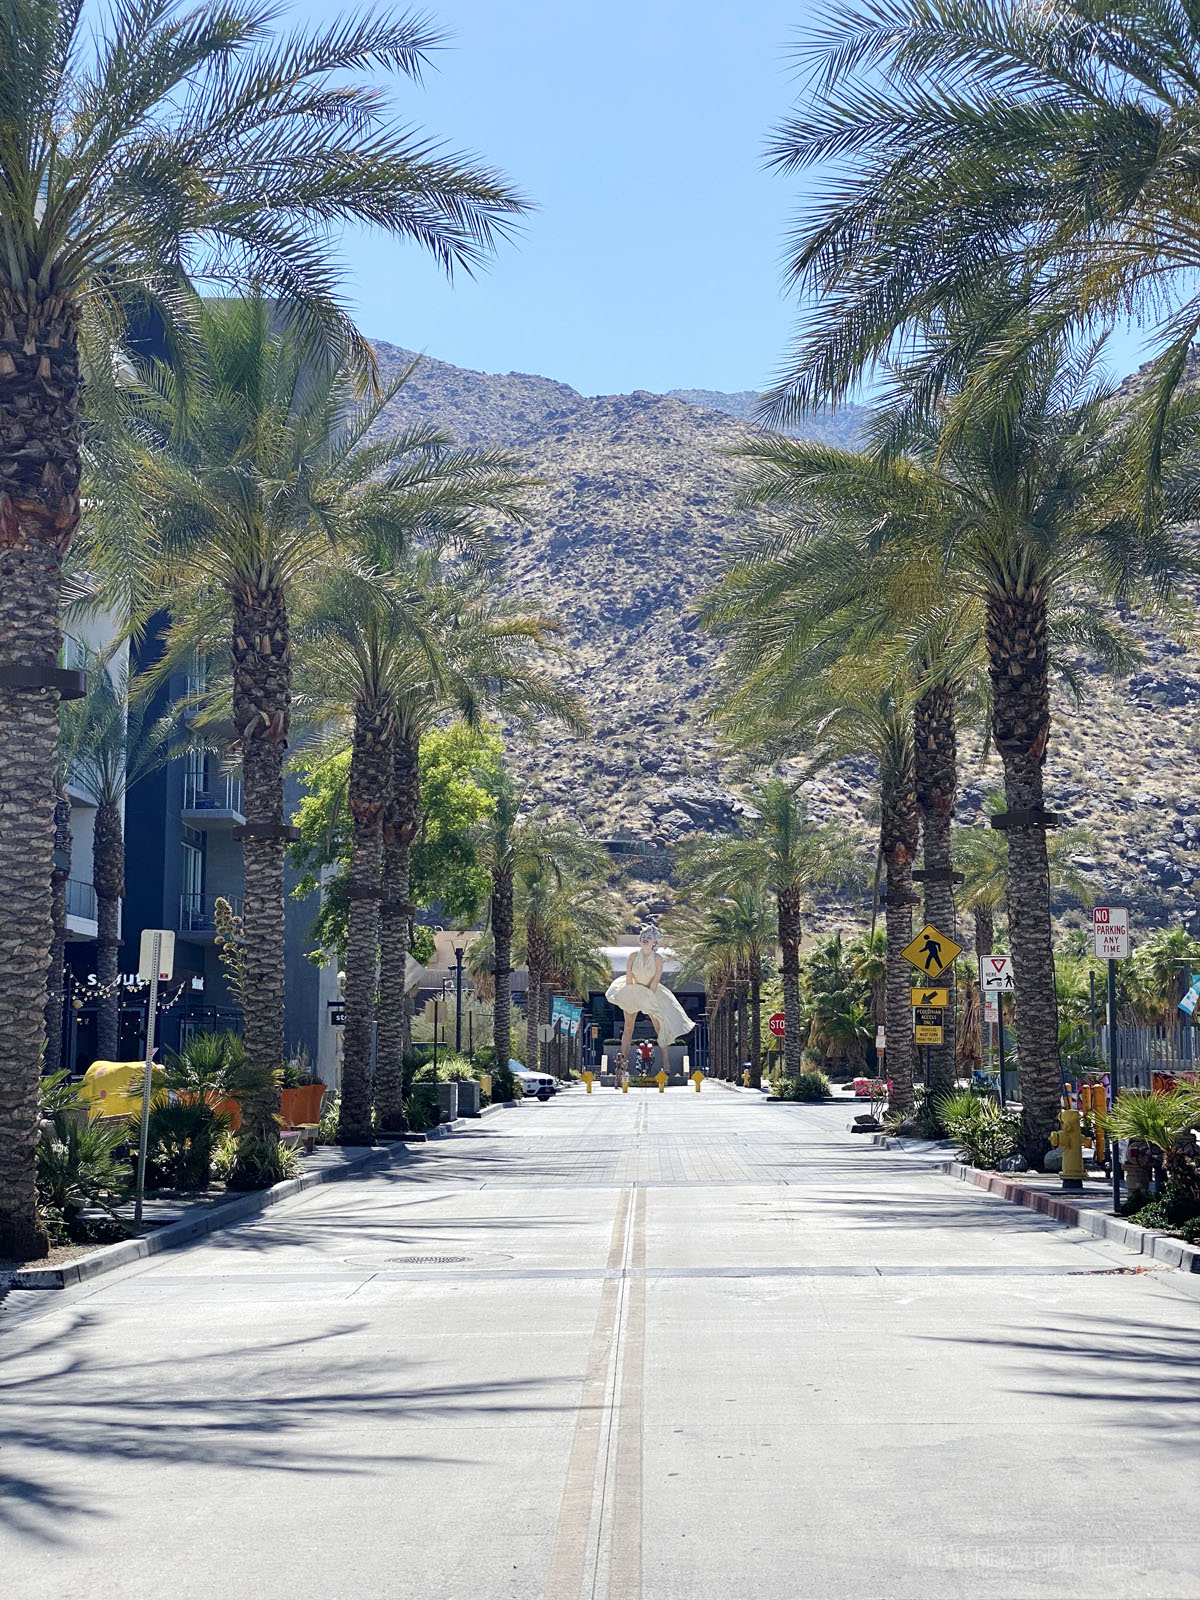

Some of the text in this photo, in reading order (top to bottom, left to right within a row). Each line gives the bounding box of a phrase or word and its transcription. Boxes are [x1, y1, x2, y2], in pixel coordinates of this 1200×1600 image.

[1095, 910, 1108, 922] NO
[1097, 925, 1126, 935] PARKING
[1104, 936, 1119, 944] ANY
[1103, 945, 1121, 953] TIME
[770, 1020, 785, 1029] STO
